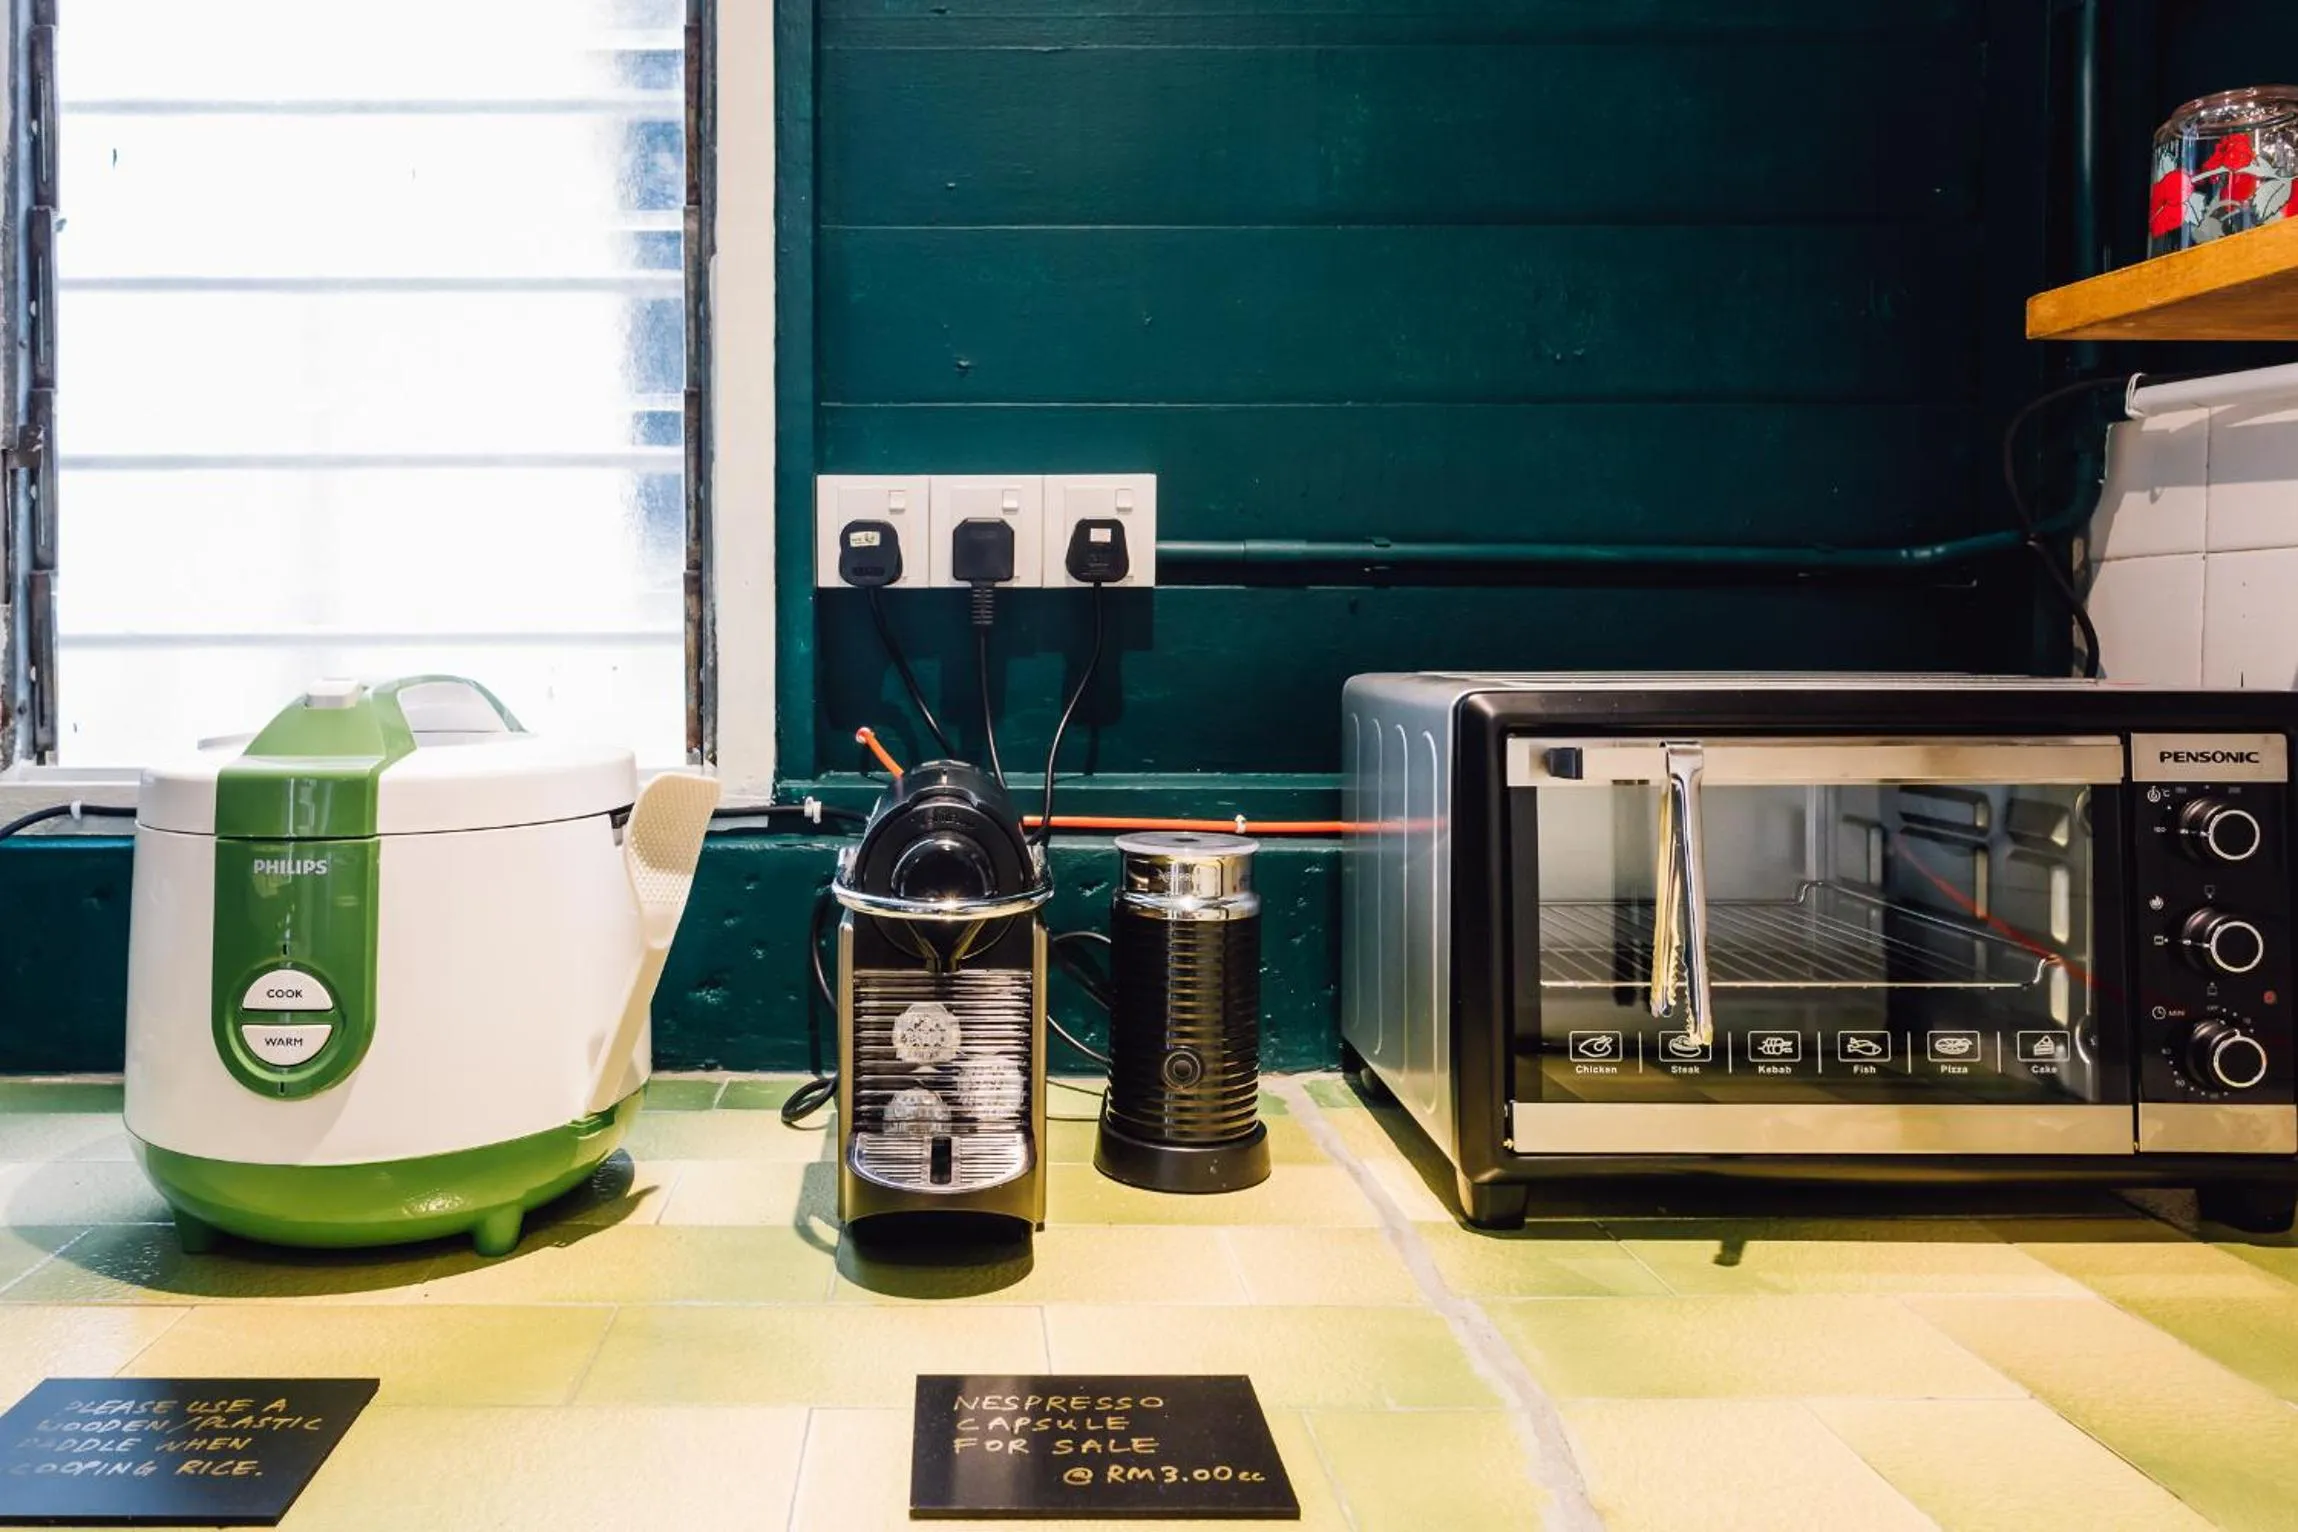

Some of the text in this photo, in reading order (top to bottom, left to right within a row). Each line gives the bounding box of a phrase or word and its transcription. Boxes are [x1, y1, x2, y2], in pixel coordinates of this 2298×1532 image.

[2159, 751, 2260, 763] PENSONIC
[253, 859, 328, 875] PHILIPS
[266, 989, 303, 999] COOK
[264, 1037, 303, 1047] WARM
[1575, 1064, 1617, 1074] Chicken
[1671, 1064, 1700, 1074] Steak
[1758, 1064, 1792, 1074] Kebab
[1853, 1064, 1876, 1074] Fish
[1940, 1065, 1968, 1074] Pizza
[2031, 1065, 2058, 1074] Cake
[65, 1399, 287, 1414] PLEASE USE A
[953, 1395, 1164, 1412] NESPRESSO
[956, 1417, 1130, 1434] CAPSULE
[155, 1437, 252, 1451] WHEN
[953, 1438, 1160, 1455] FOR SALE
[175, 1459, 263, 1476] RICE.
[1063, 1467, 1093, 1485] @
